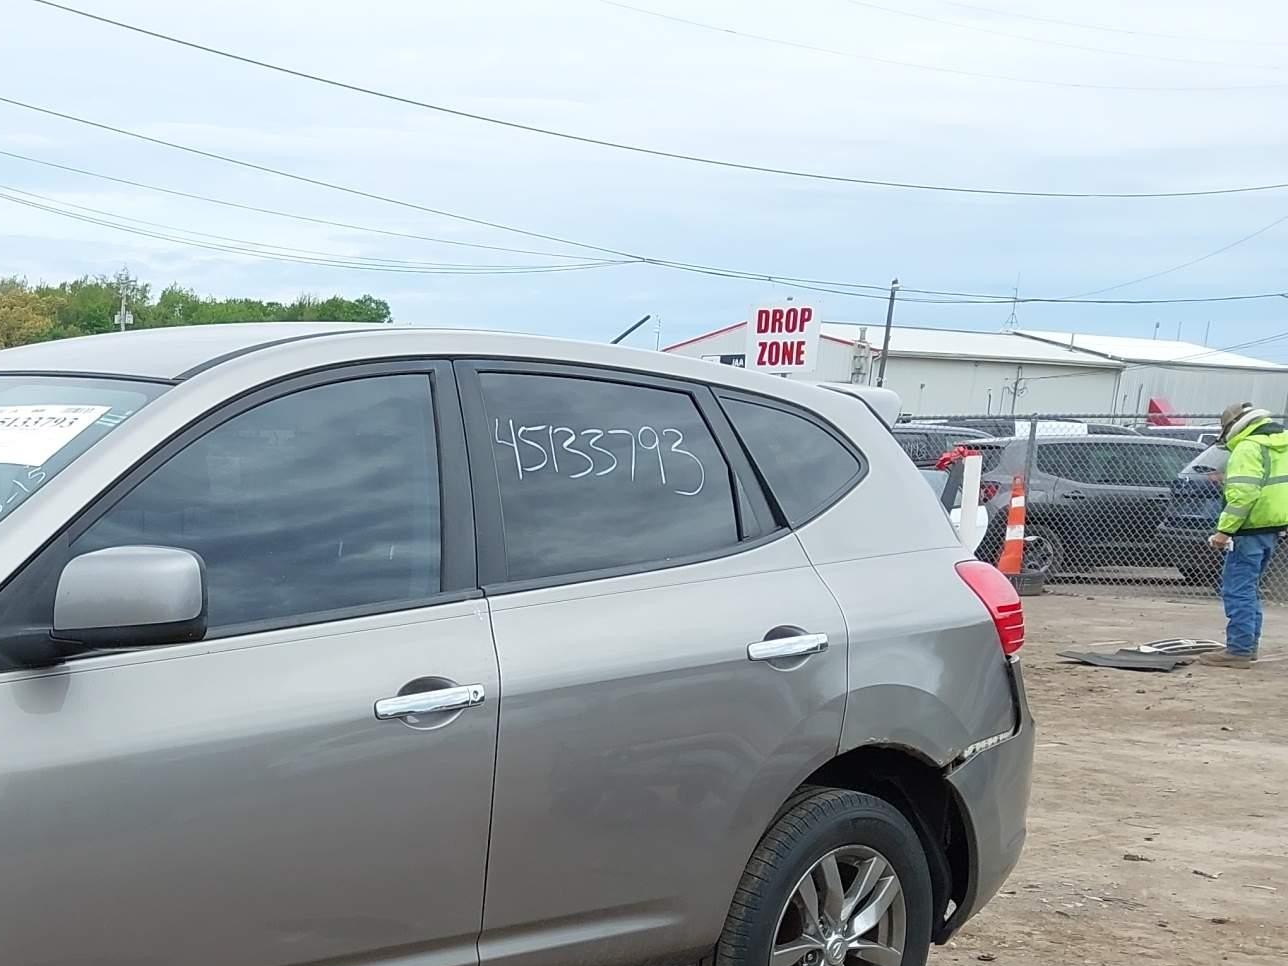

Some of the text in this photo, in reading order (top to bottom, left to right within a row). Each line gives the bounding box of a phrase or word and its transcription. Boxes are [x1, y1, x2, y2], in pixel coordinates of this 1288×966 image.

[756, 307, 813, 334] DROP
[756, 340, 806, 366] ZONE
[495, 417, 705, 496] 45133793
